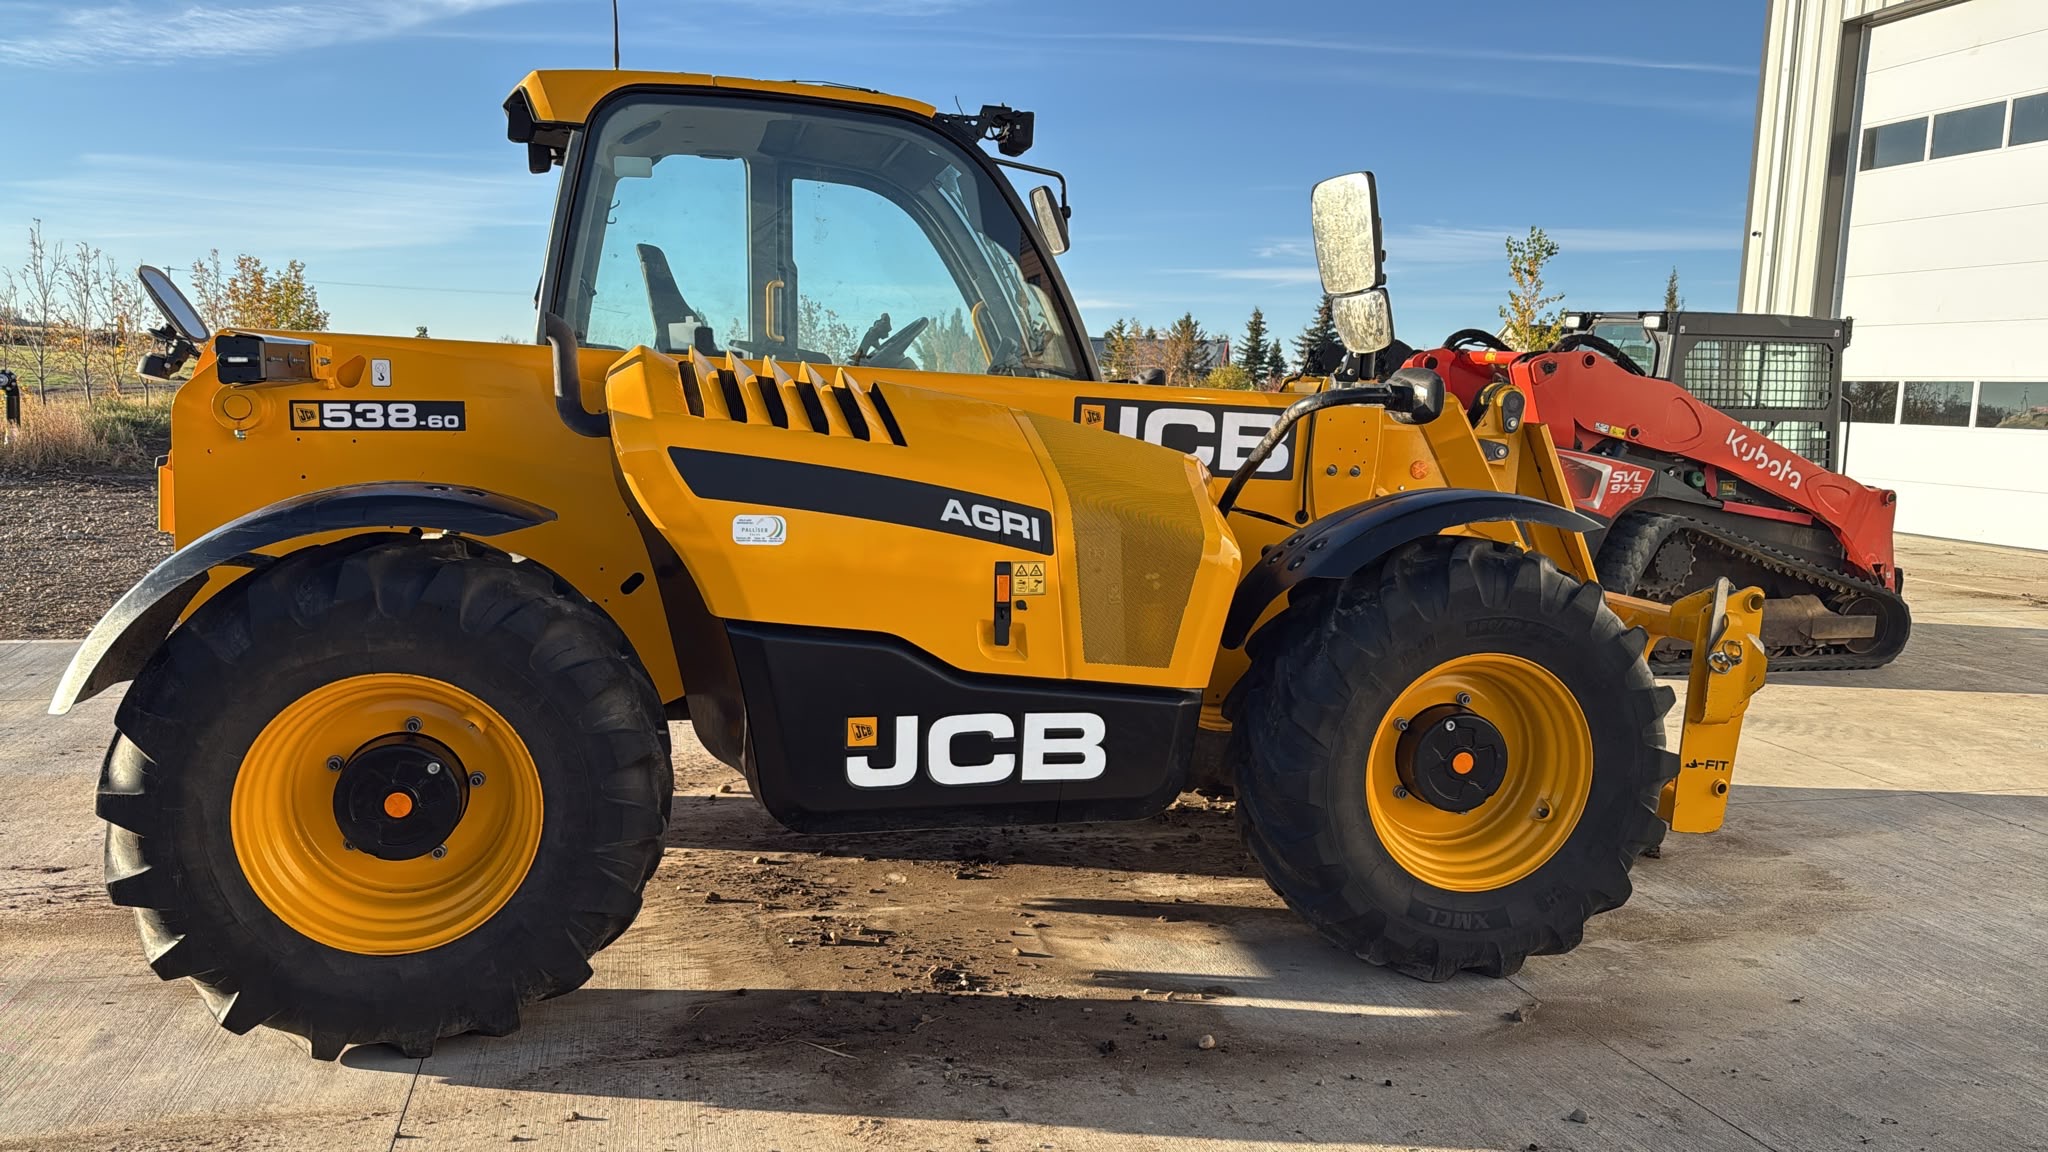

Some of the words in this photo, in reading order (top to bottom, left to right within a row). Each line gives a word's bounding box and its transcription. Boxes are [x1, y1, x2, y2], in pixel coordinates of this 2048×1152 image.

[322, 403, 460, 429] 538-60
[1084, 409, 1102, 425] JCB
[1725, 428, 1802, 490] Kubota
[1610, 471, 1645, 483] SVL
[1610, 484, 1643, 494] 97-3
[940, 498, 1041, 542] AGRI
[851, 723, 874, 741] JCB
[847, 713, 1106, 787] JCB
